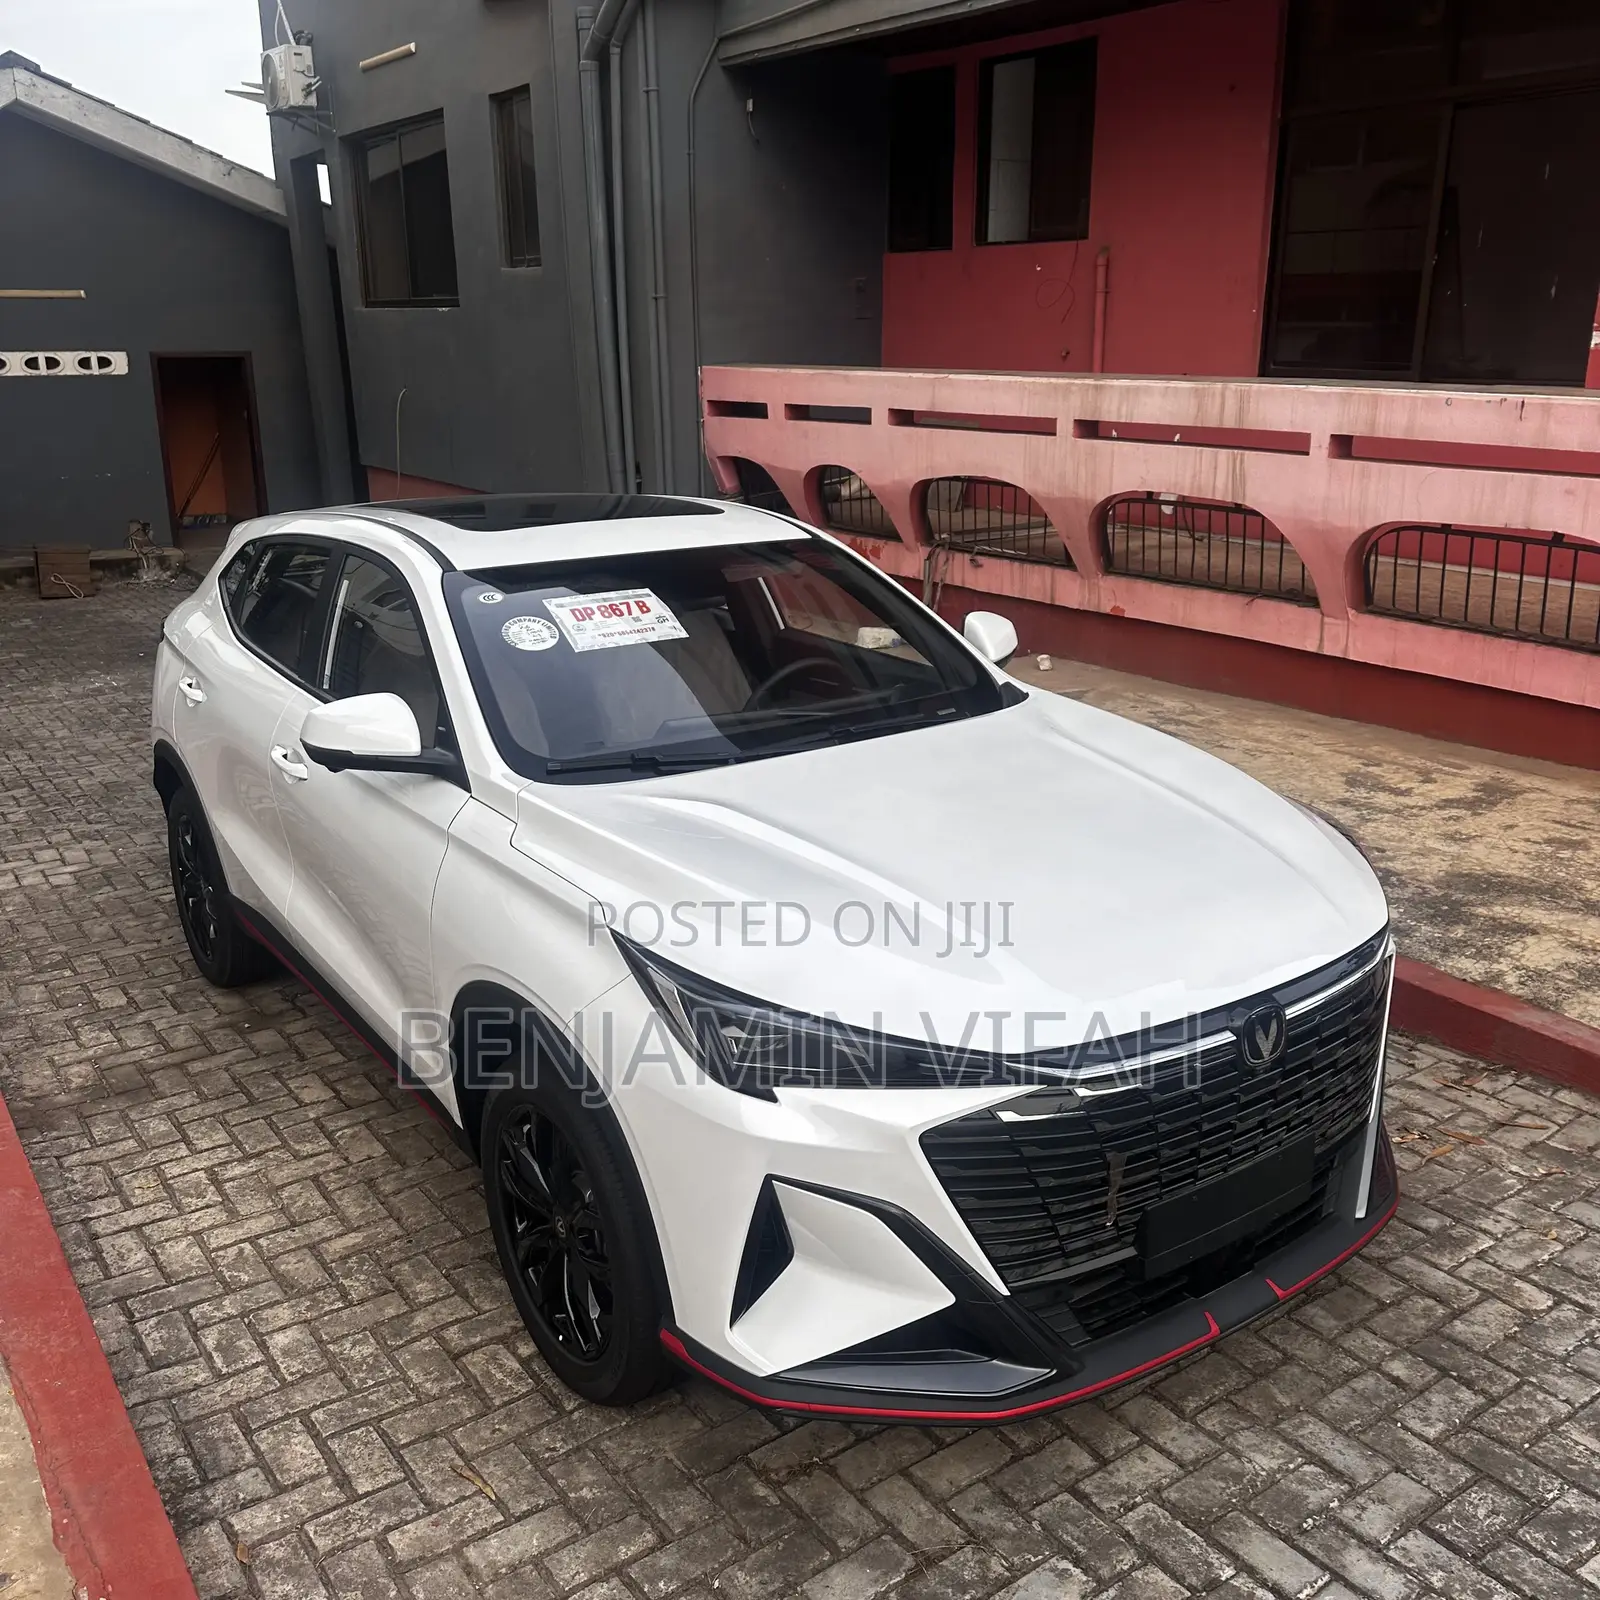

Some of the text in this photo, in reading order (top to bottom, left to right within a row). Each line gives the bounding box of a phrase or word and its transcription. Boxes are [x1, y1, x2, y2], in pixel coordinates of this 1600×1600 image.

[569, 600, 651, 622] DP 867 B
[508, 617, 541, 626] COMPANY
